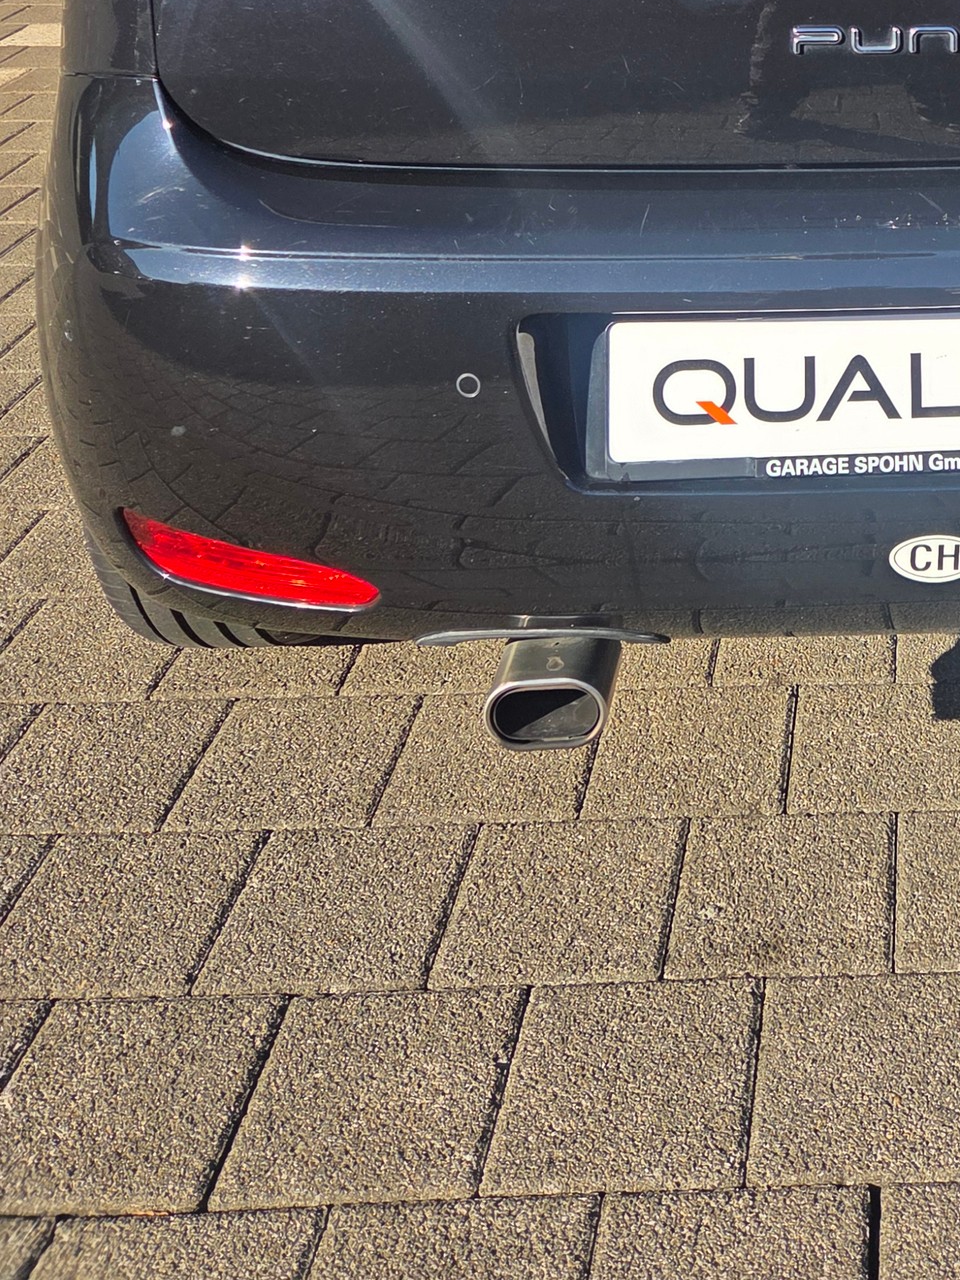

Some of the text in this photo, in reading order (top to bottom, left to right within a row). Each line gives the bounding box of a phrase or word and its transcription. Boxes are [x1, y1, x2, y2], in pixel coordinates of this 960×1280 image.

[765, 457, 849, 478] GARAGE
[854, 454, 924, 473] SPOHN
[909, 544, 960, 572] CH
